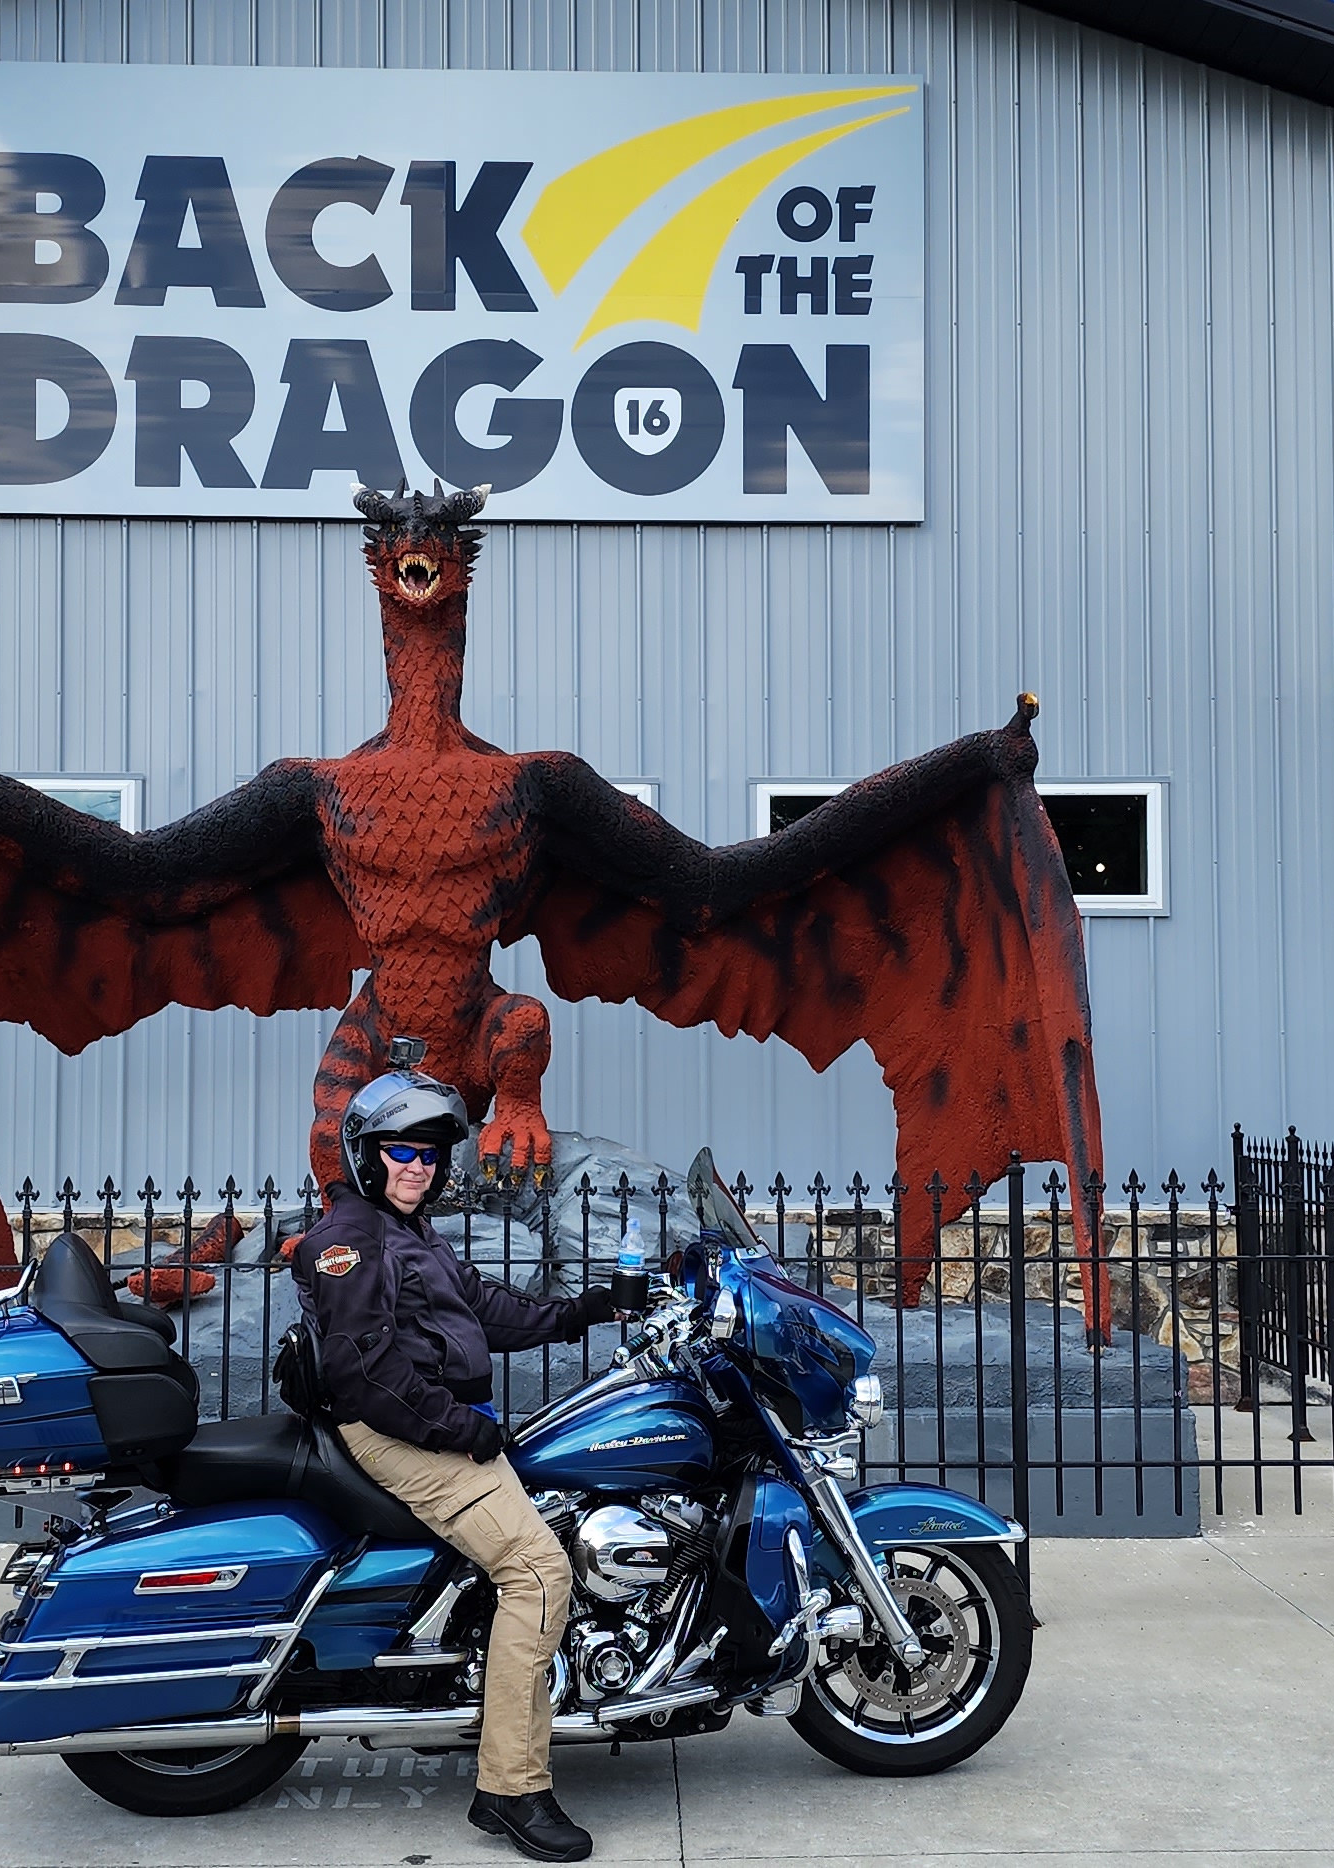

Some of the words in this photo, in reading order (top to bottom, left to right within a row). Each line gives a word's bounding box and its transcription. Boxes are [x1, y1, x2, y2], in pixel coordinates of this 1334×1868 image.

[776, 184, 877, 243] OF
[734, 253, 875, 316] THE
[626, 399, 671, 437] 16
[909, 1516, 967, 1535] Limited
[241, 1786, 439, 1809] NLY
